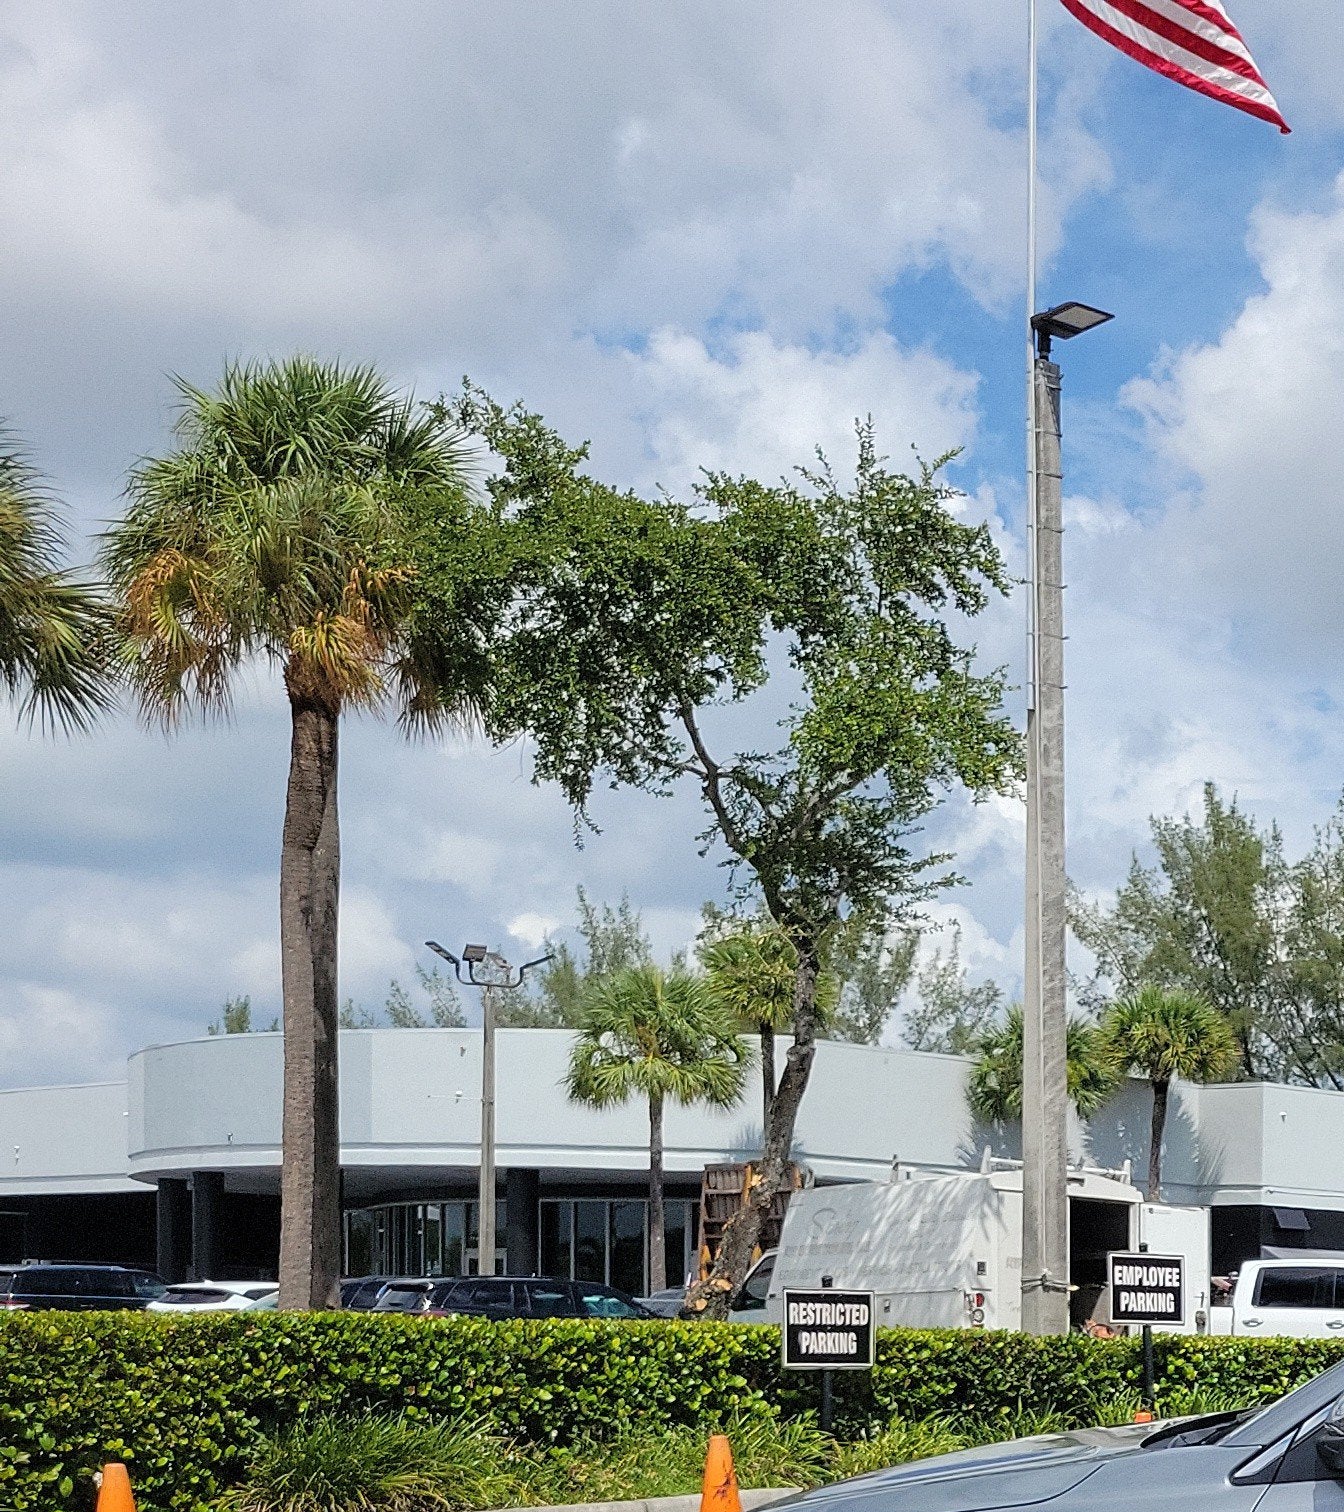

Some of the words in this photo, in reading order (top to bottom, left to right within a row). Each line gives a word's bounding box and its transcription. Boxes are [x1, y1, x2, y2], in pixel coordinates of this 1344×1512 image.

[1114, 1265, 1180, 1288] EMPLOYEE
[1120, 1291, 1175, 1313] PARKING
[789, 1302, 869, 1326] RESTRICTED
[799, 1331, 857, 1354] PARKING
